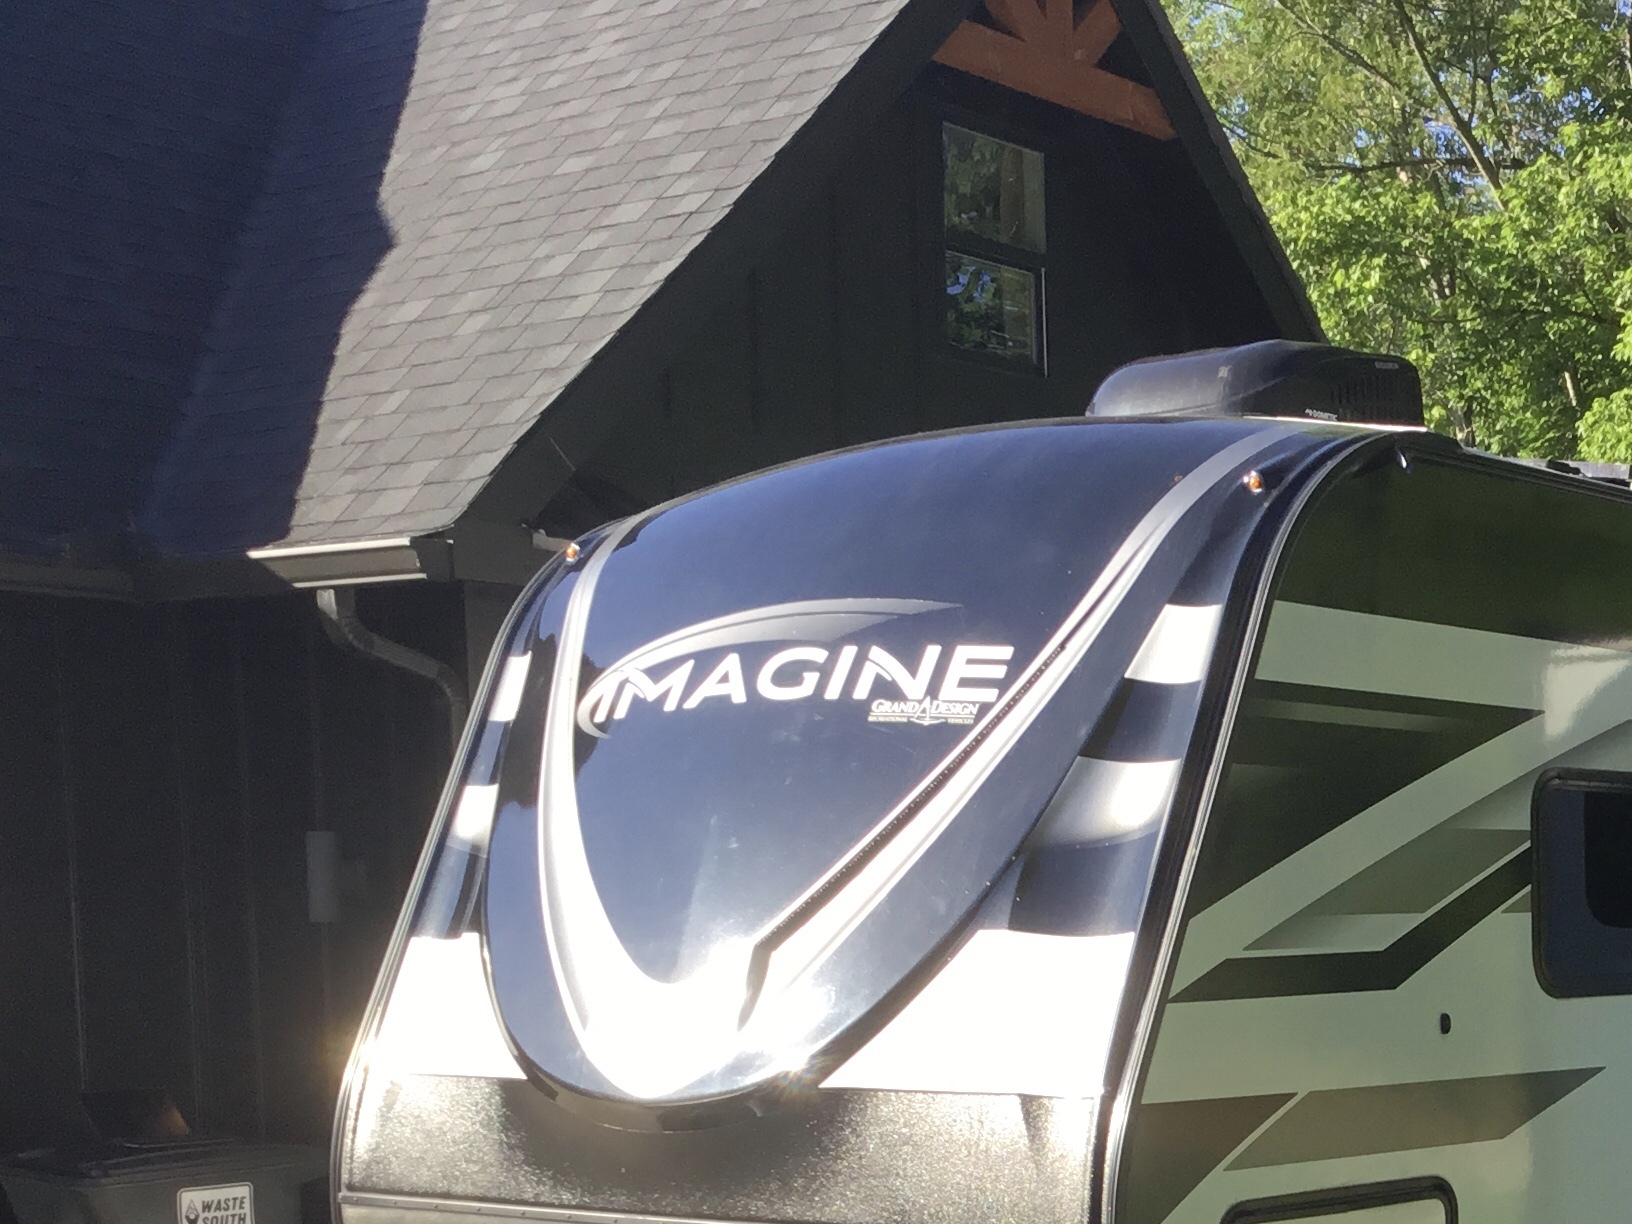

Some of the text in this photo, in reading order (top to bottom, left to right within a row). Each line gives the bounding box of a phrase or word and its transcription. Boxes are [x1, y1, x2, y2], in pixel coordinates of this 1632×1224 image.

[592, 644, 1015, 725] IMAGINE
[871, 699, 980, 715] GRAND DESIGN
[201, 1195, 247, 1214] WASTE
